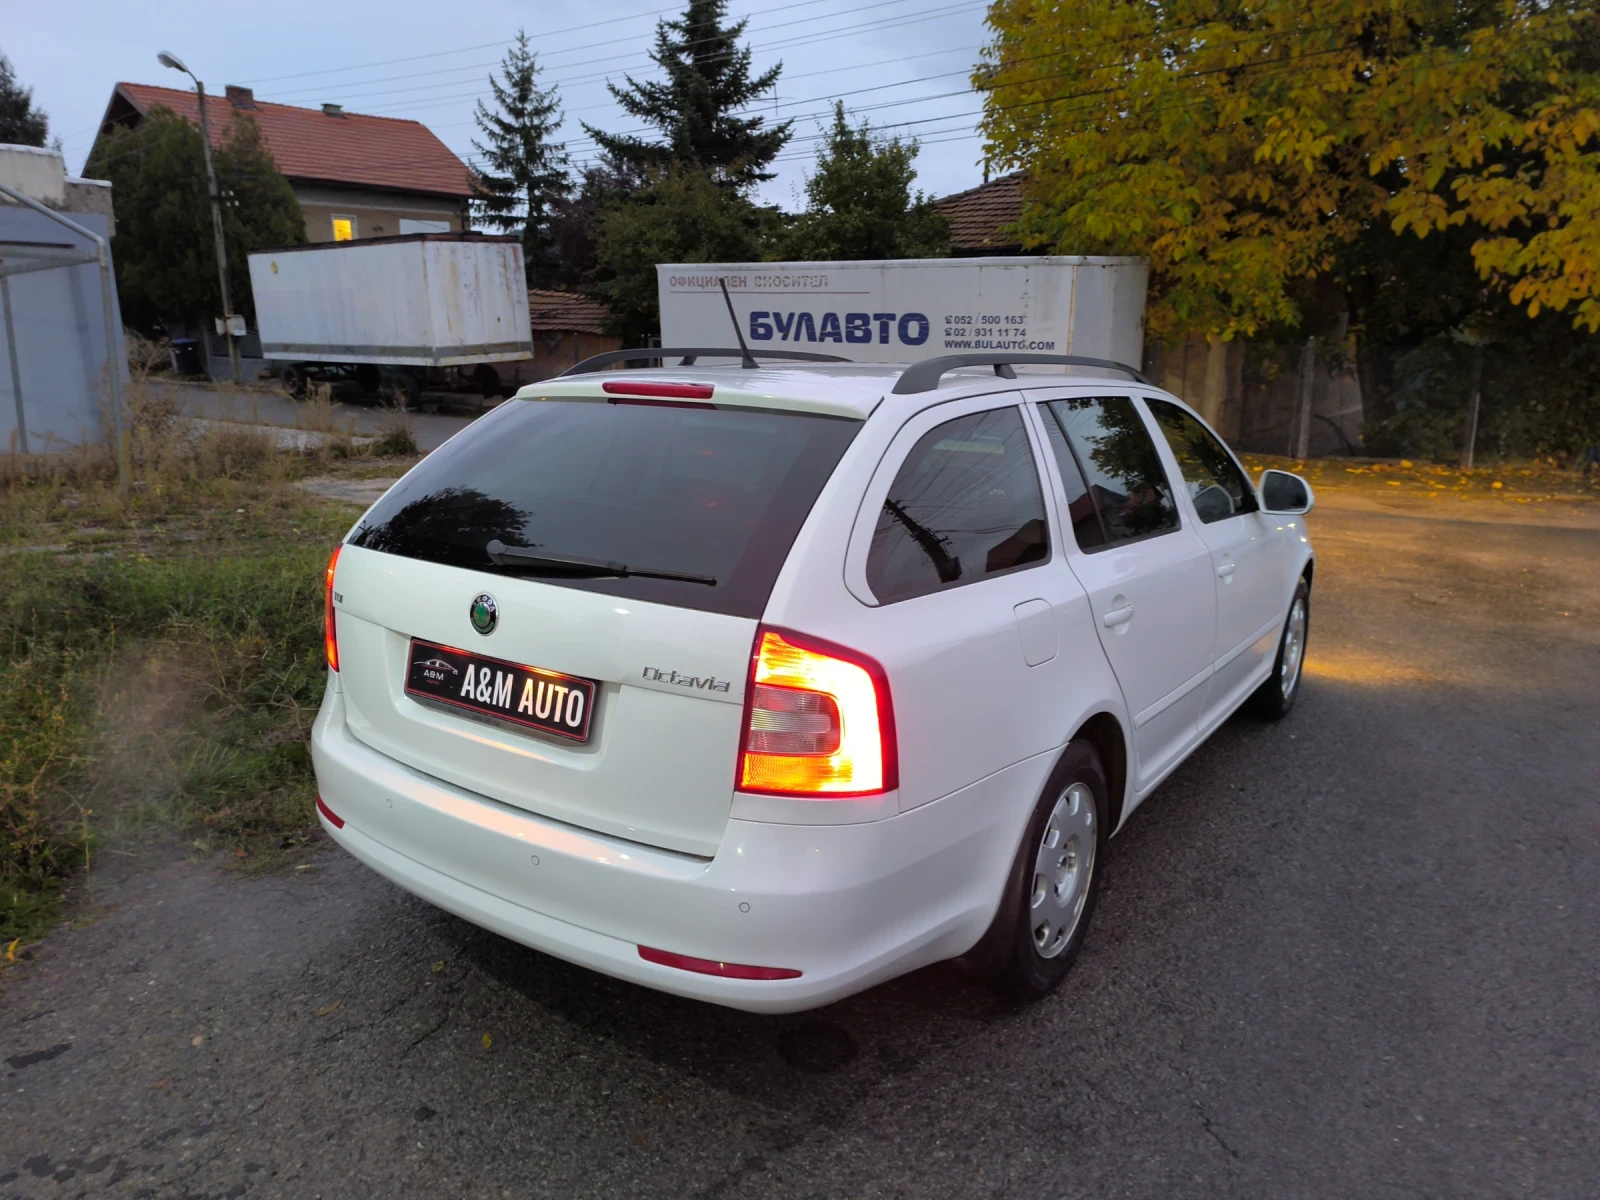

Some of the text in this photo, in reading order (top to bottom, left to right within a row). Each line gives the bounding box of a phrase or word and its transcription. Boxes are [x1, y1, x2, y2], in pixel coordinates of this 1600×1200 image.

[749, 311, 930, 346] БУЛАВТО
[953, 315, 973, 325] 052
[981, 315, 1001, 325] 500
[1004, 315, 1024, 325] 163
[953, 327, 967, 337] 02
[974, 327, 994, 337] 931
[1013, 328, 1027, 337] 74
[944, 340, 1055, 350] WWW.BULAUTO.COM
[642, 665, 731, 692] Octavia
[460, 663, 585, 728] A&M AUTO
